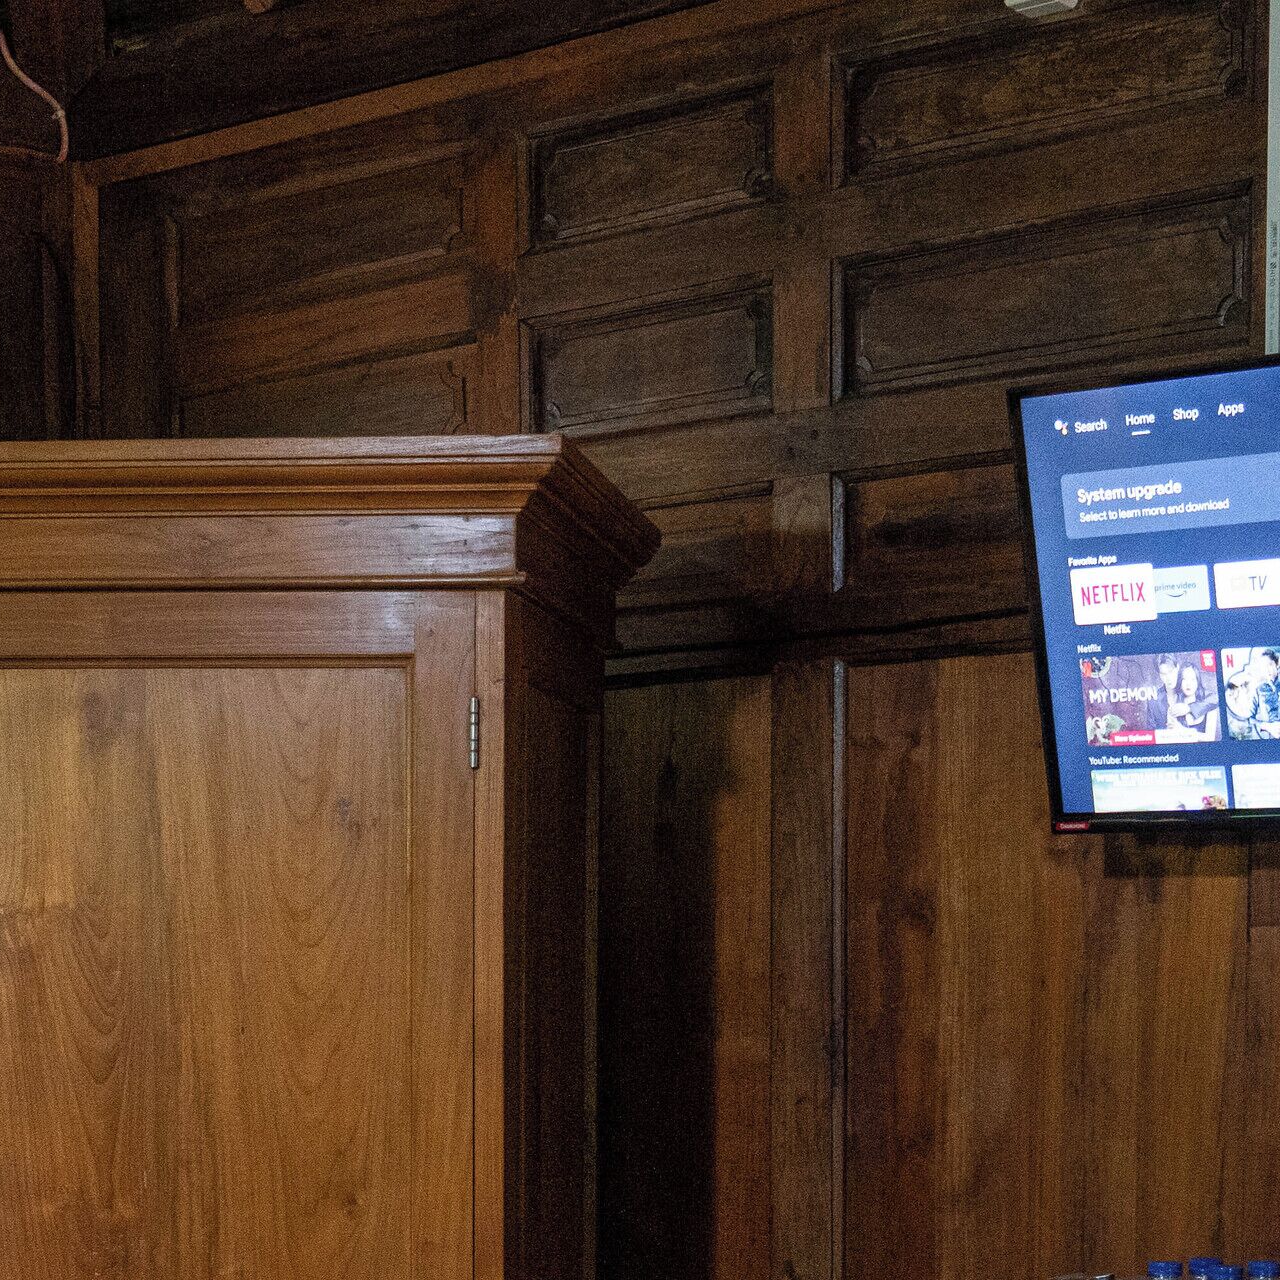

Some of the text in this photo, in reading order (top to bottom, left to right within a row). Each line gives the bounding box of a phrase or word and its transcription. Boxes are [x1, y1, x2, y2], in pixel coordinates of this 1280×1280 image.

[1173, 407, 1199, 421] Shop
[1217, 403, 1245, 416] Apps
[1074, 418, 1108, 433] Search
[1125, 413, 1156, 426] Home
[1077, 480, 1182, 505] System upgrade
[1080, 498, 1229, 523] Select to learn more and download
[1067, 554, 1117, 567] Favorite Apps
[1154, 580, 1197, 594] prime video
[1248, 575, 1268, 591] TV
[1081, 582, 1146, 607] NETFLIX
[1103, 624, 1131, 635] Netflix
[1077, 643, 1101, 653] Netflix
[1089, 686, 1158, 703] MY DEMON
[1089, 753, 1179, 766] YouTube: Recommended
